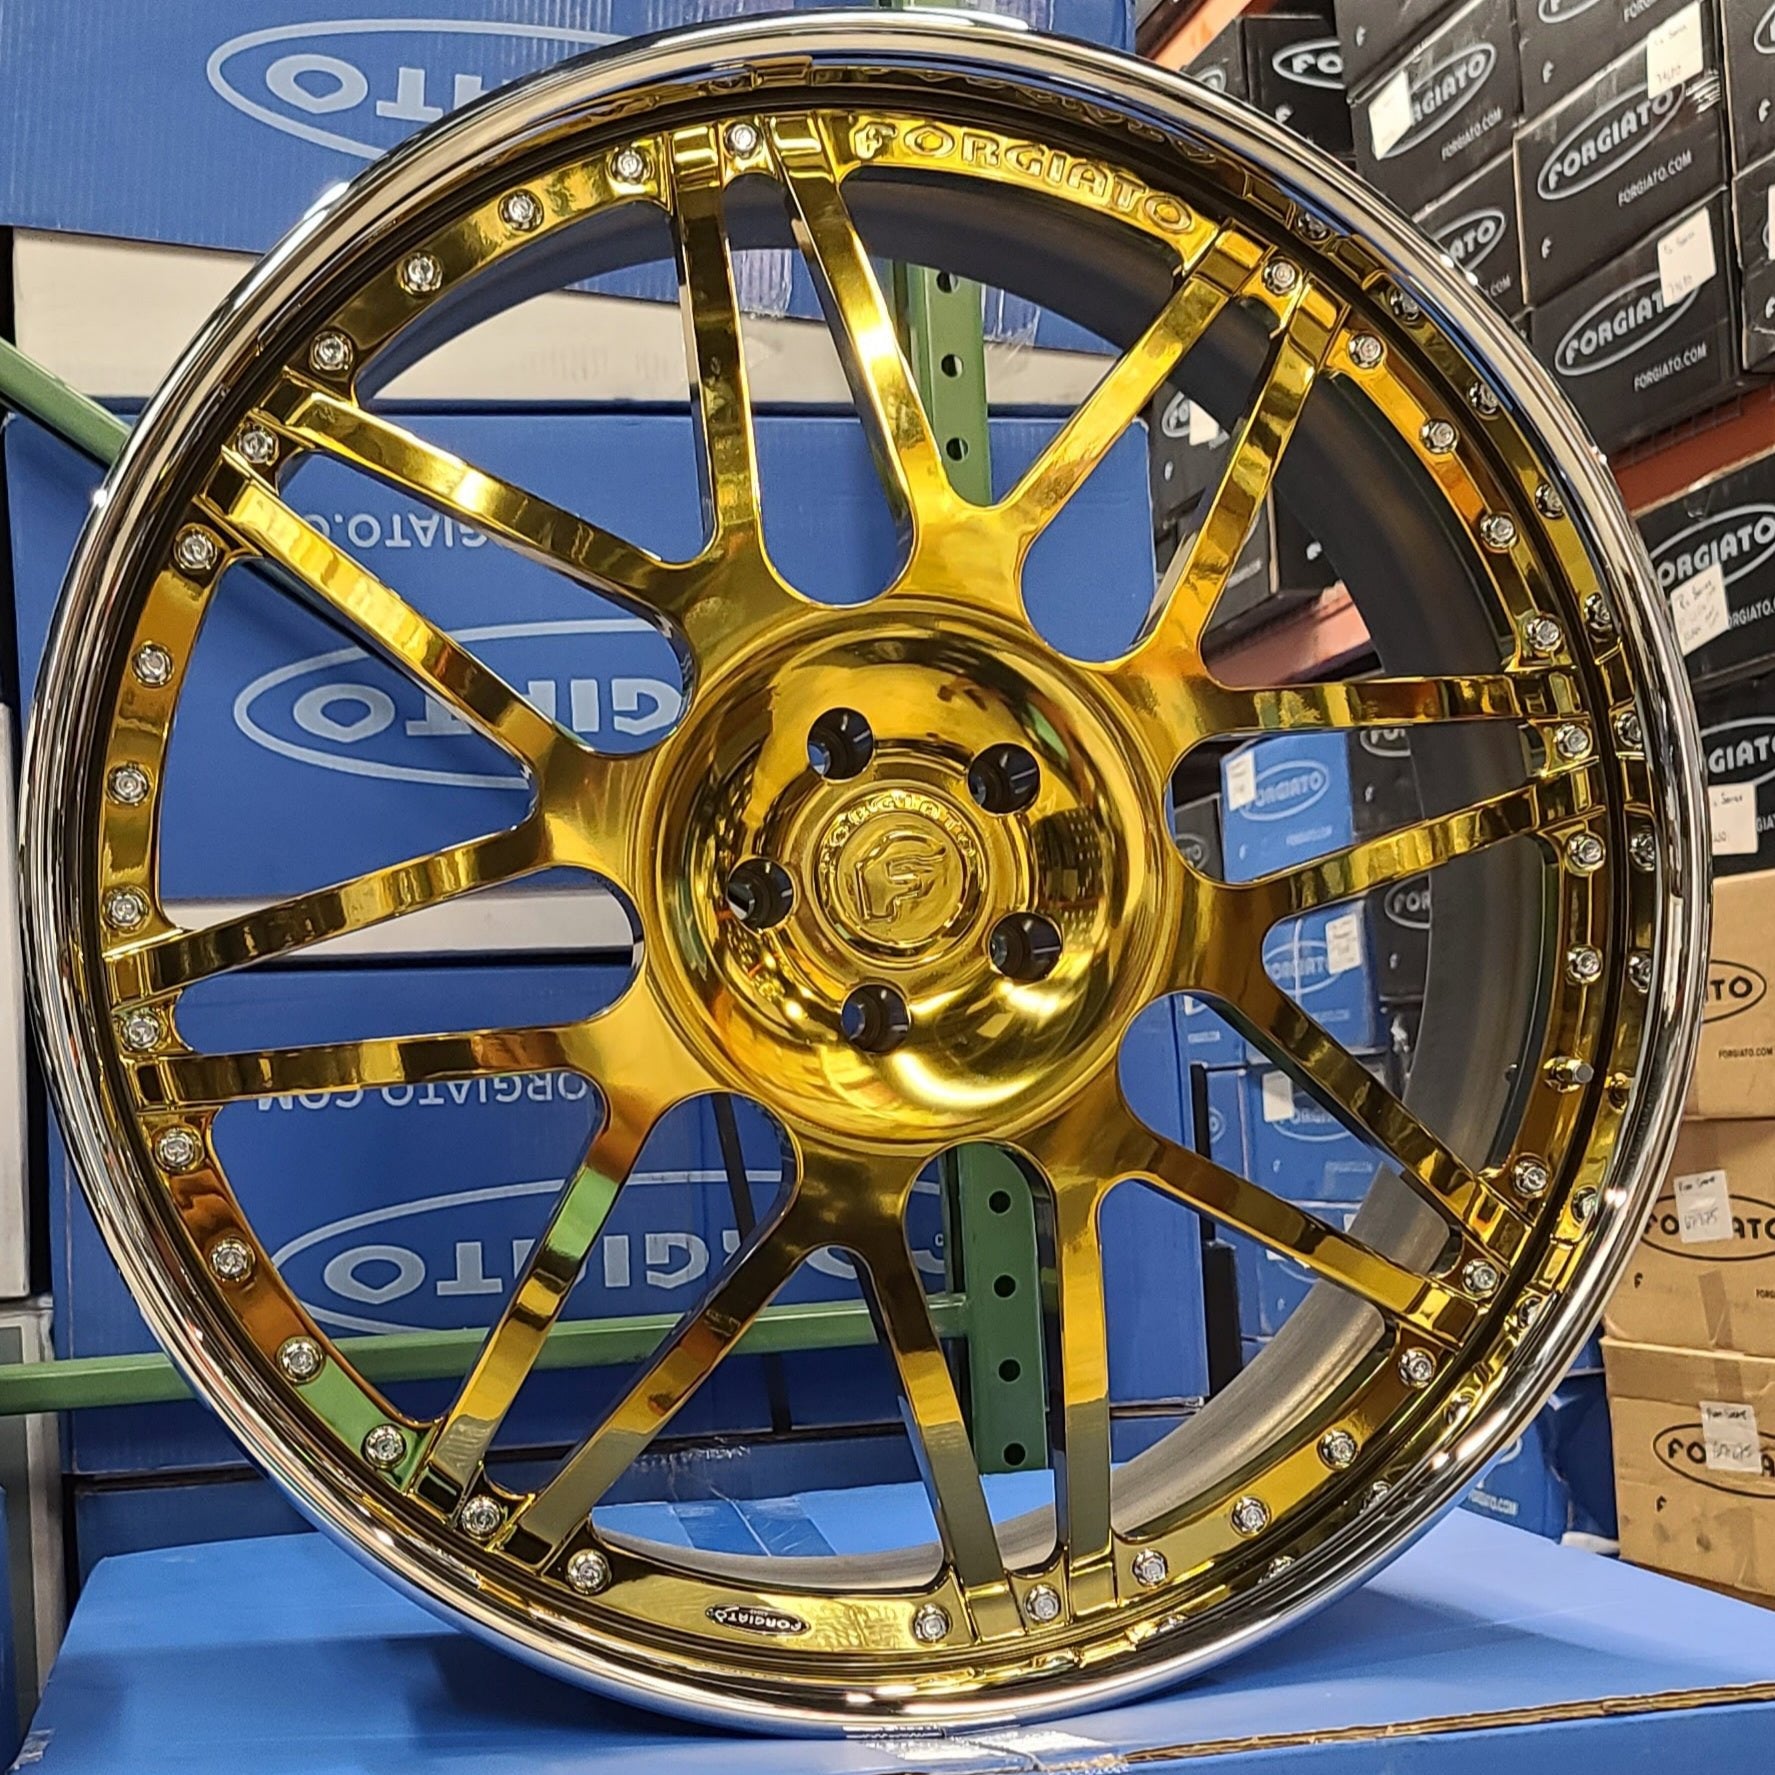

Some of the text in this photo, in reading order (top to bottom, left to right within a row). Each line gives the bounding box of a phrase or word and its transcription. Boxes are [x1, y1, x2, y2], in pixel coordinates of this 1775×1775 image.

[1413, 52, 1486, 123] RGIATO
[1547, 88, 1674, 191] FORGIATO
[853, 120, 1195, 234] FORGIATO
[1618, 149, 1693, 207] FORGIATO.COM
[1565, 290, 1664, 366] FORGIAT
[1634, 342, 1708, 392] FORGIATO.COM
[1657, 515, 1775, 587] ORGIATO
[1718, 1047, 1773, 1059] FORGIATO.COM
[714, 1606, 802, 1633] FORGIATO
